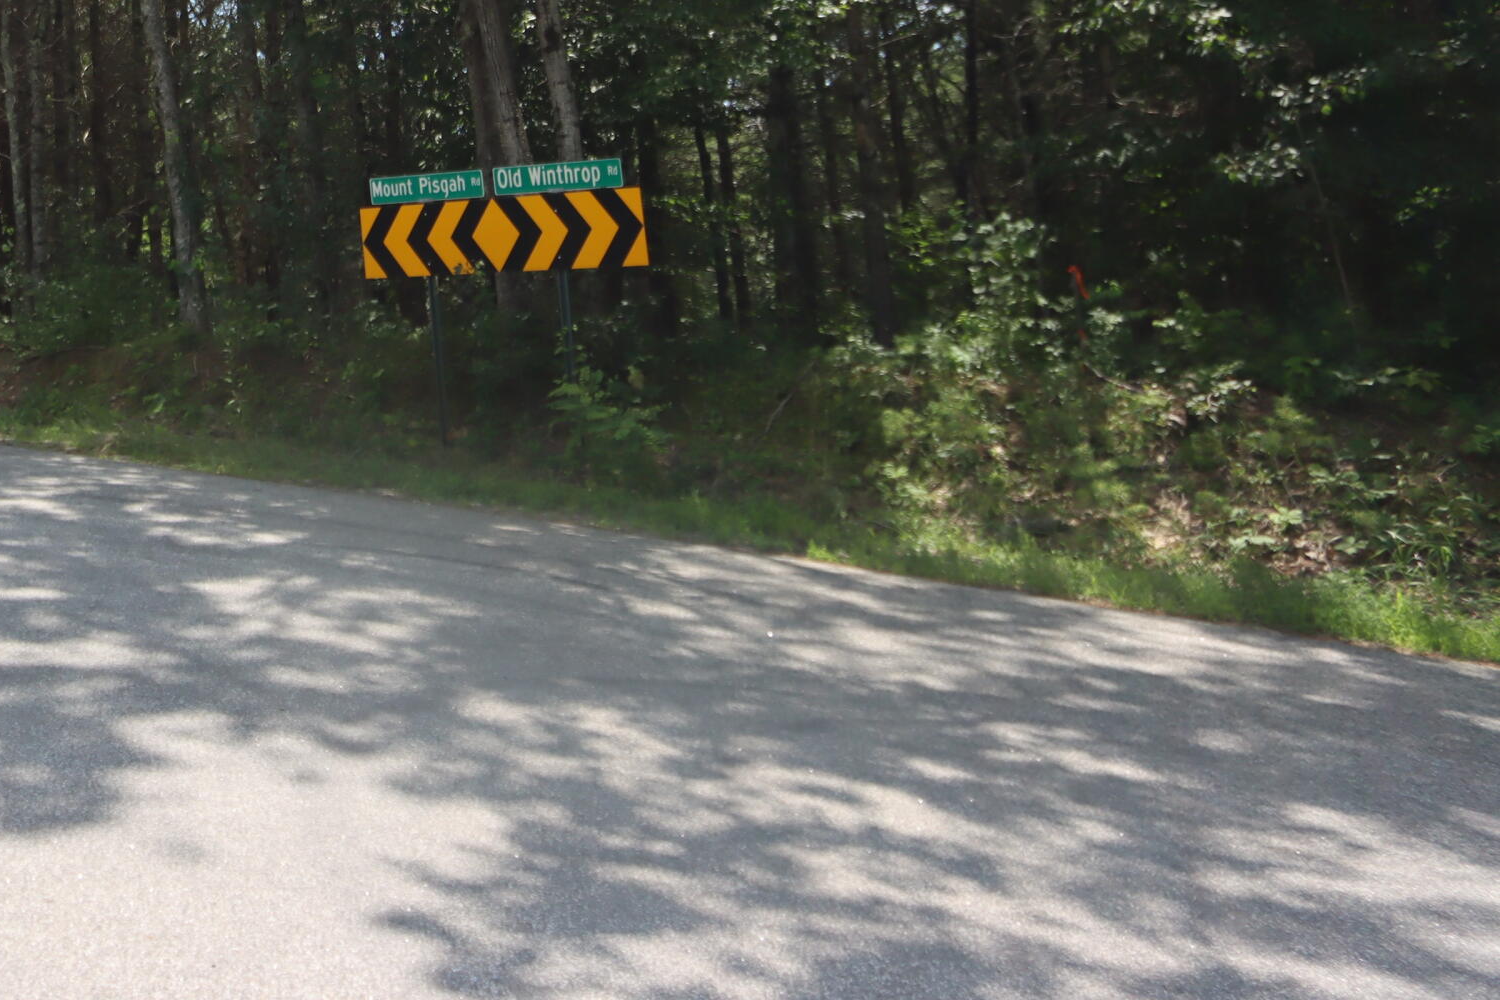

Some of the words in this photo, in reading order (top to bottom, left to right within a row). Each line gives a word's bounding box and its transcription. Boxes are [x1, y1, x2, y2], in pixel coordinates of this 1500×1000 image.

[371, 179, 413, 198] Mount
[419, 175, 466, 198] Pisgah
[470, 176, 481, 187] Rd
[497, 168, 522, 189] Old
[528, 165, 601, 187] Winthrop
[607, 165, 618, 176] Rd
